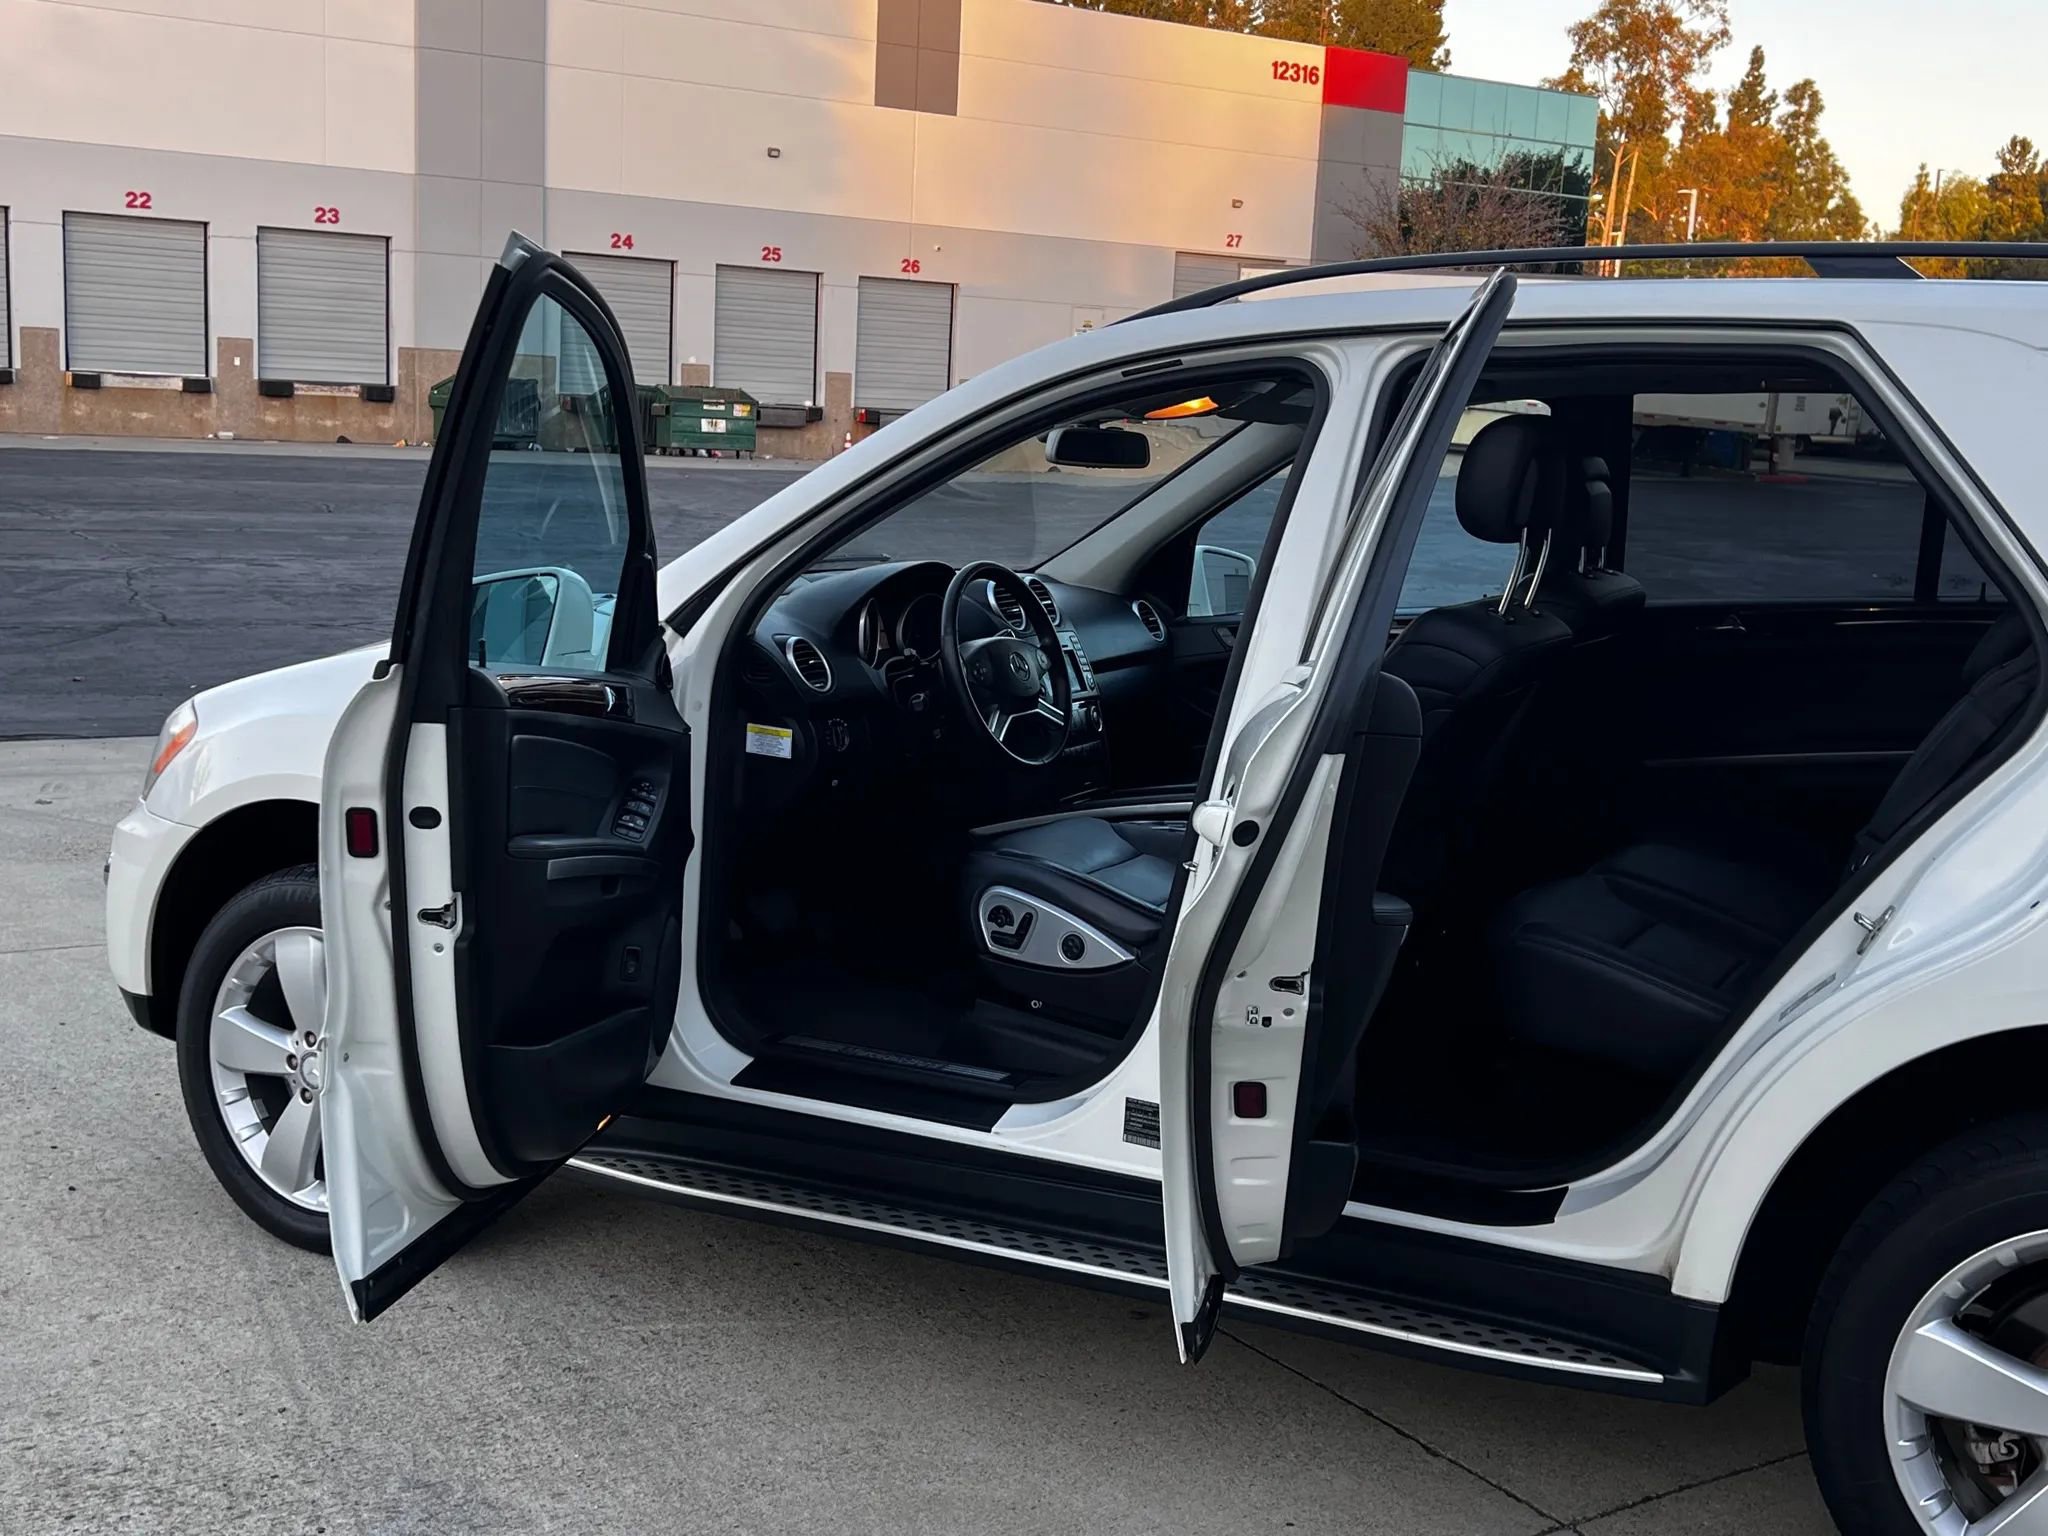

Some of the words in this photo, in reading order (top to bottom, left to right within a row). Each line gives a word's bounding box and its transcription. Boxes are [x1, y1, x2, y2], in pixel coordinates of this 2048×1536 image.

[1272, 60, 1320, 85] 12316
[125, 191, 152, 209] 22
[314, 207, 340, 224] 23
[610, 233, 634, 250] 24
[1226, 234, 1243, 248] 27
[761, 246, 782, 262] 25
[901, 258, 921, 274] 26
